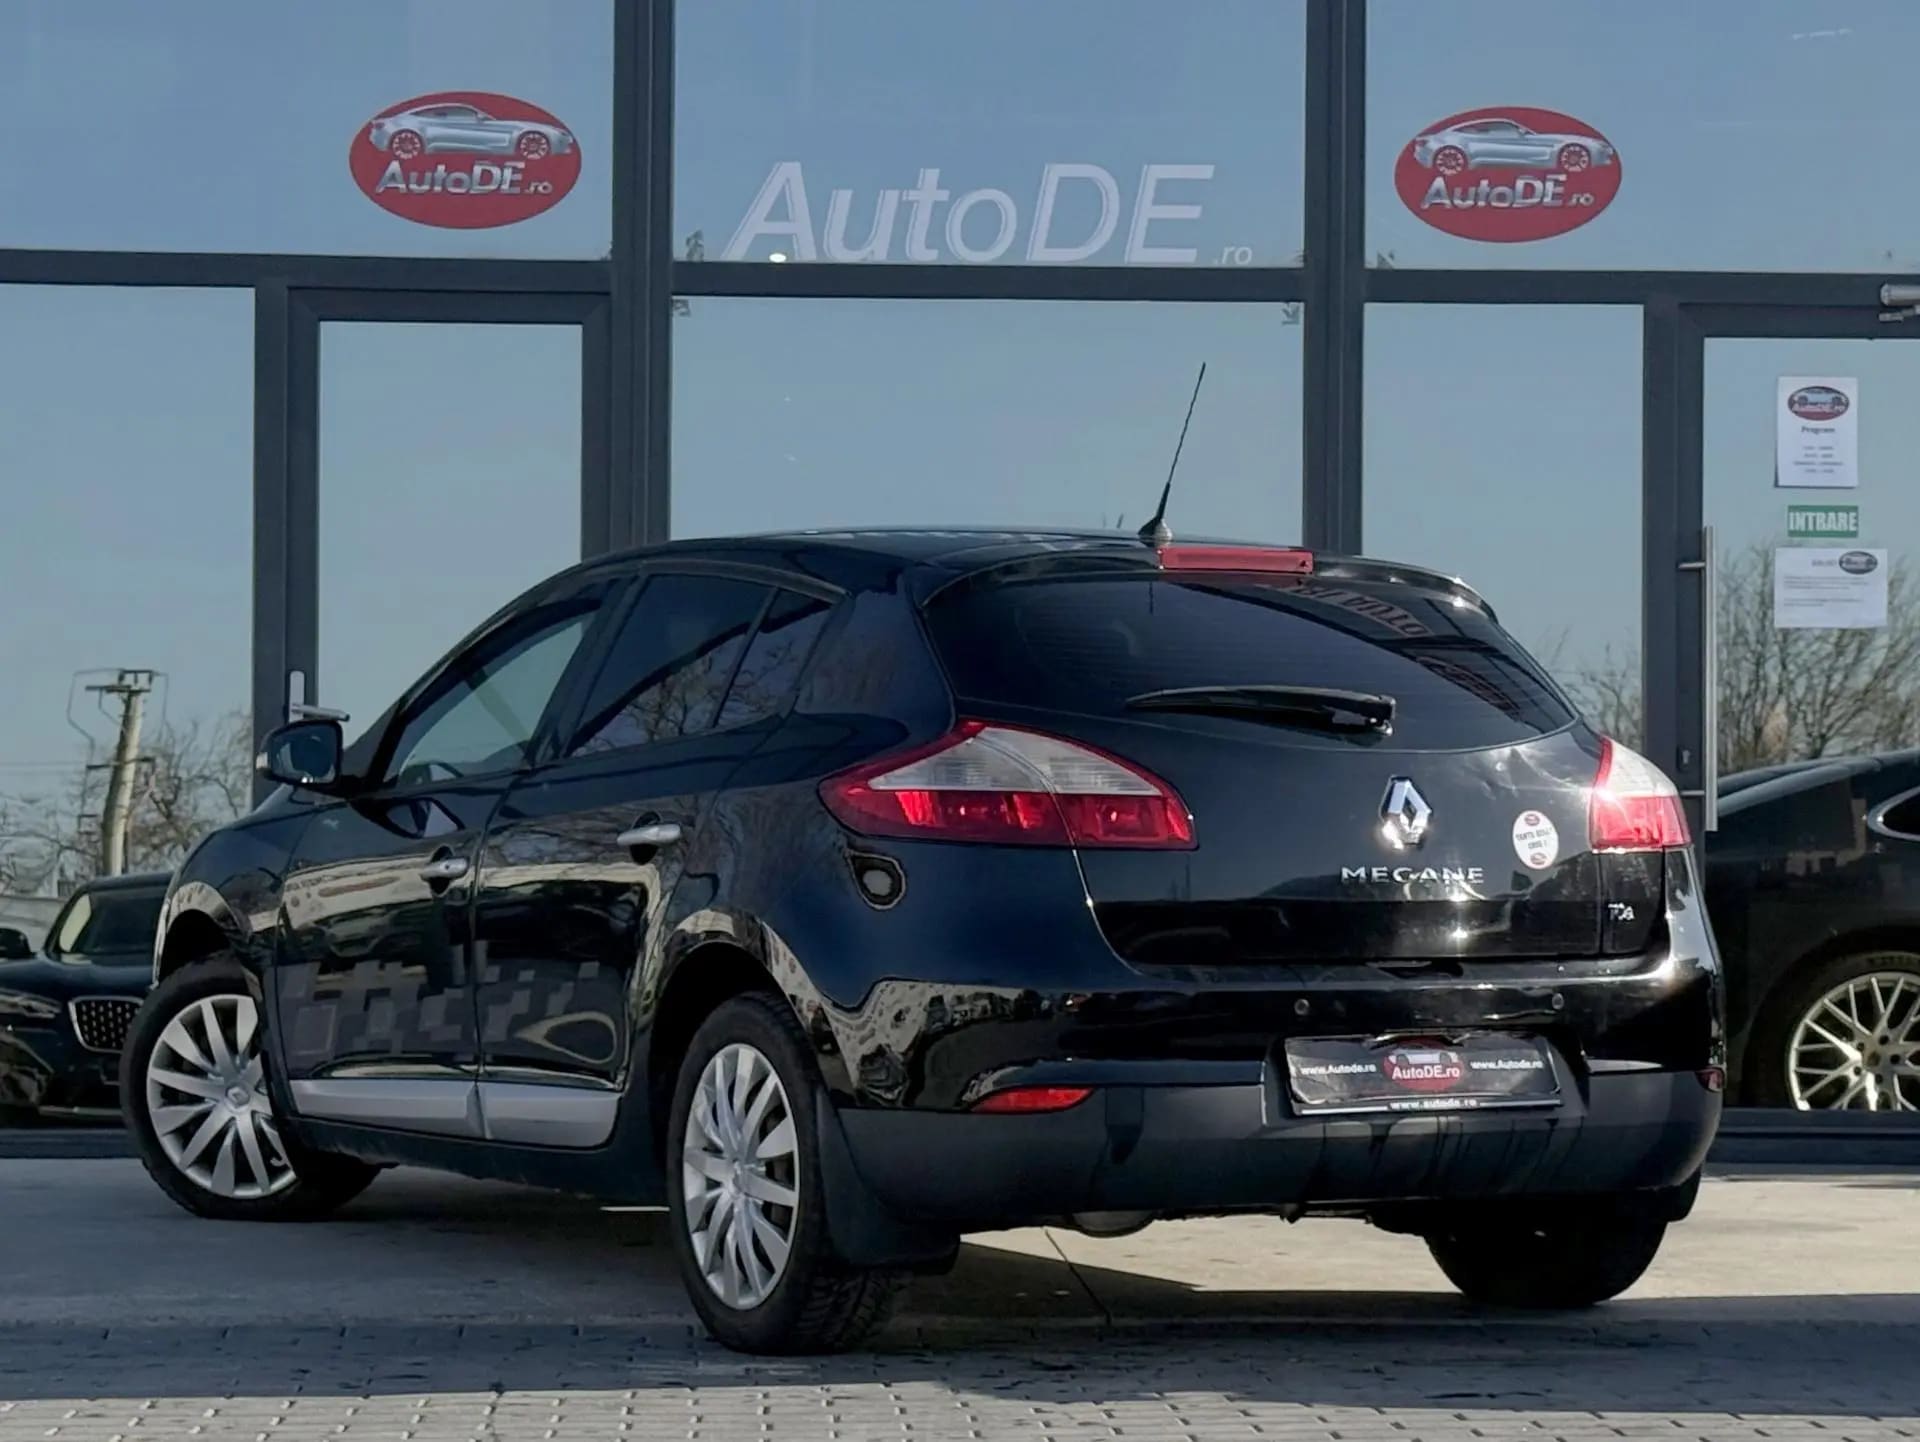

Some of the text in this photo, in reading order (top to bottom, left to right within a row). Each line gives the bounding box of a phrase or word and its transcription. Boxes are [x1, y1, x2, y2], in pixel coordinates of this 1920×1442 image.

[1788, 511, 1858, 532] INTRARE
[1341, 866, 1484, 883] MEGANE
[1391, 1065, 1461, 1080] AutoDE.ro
